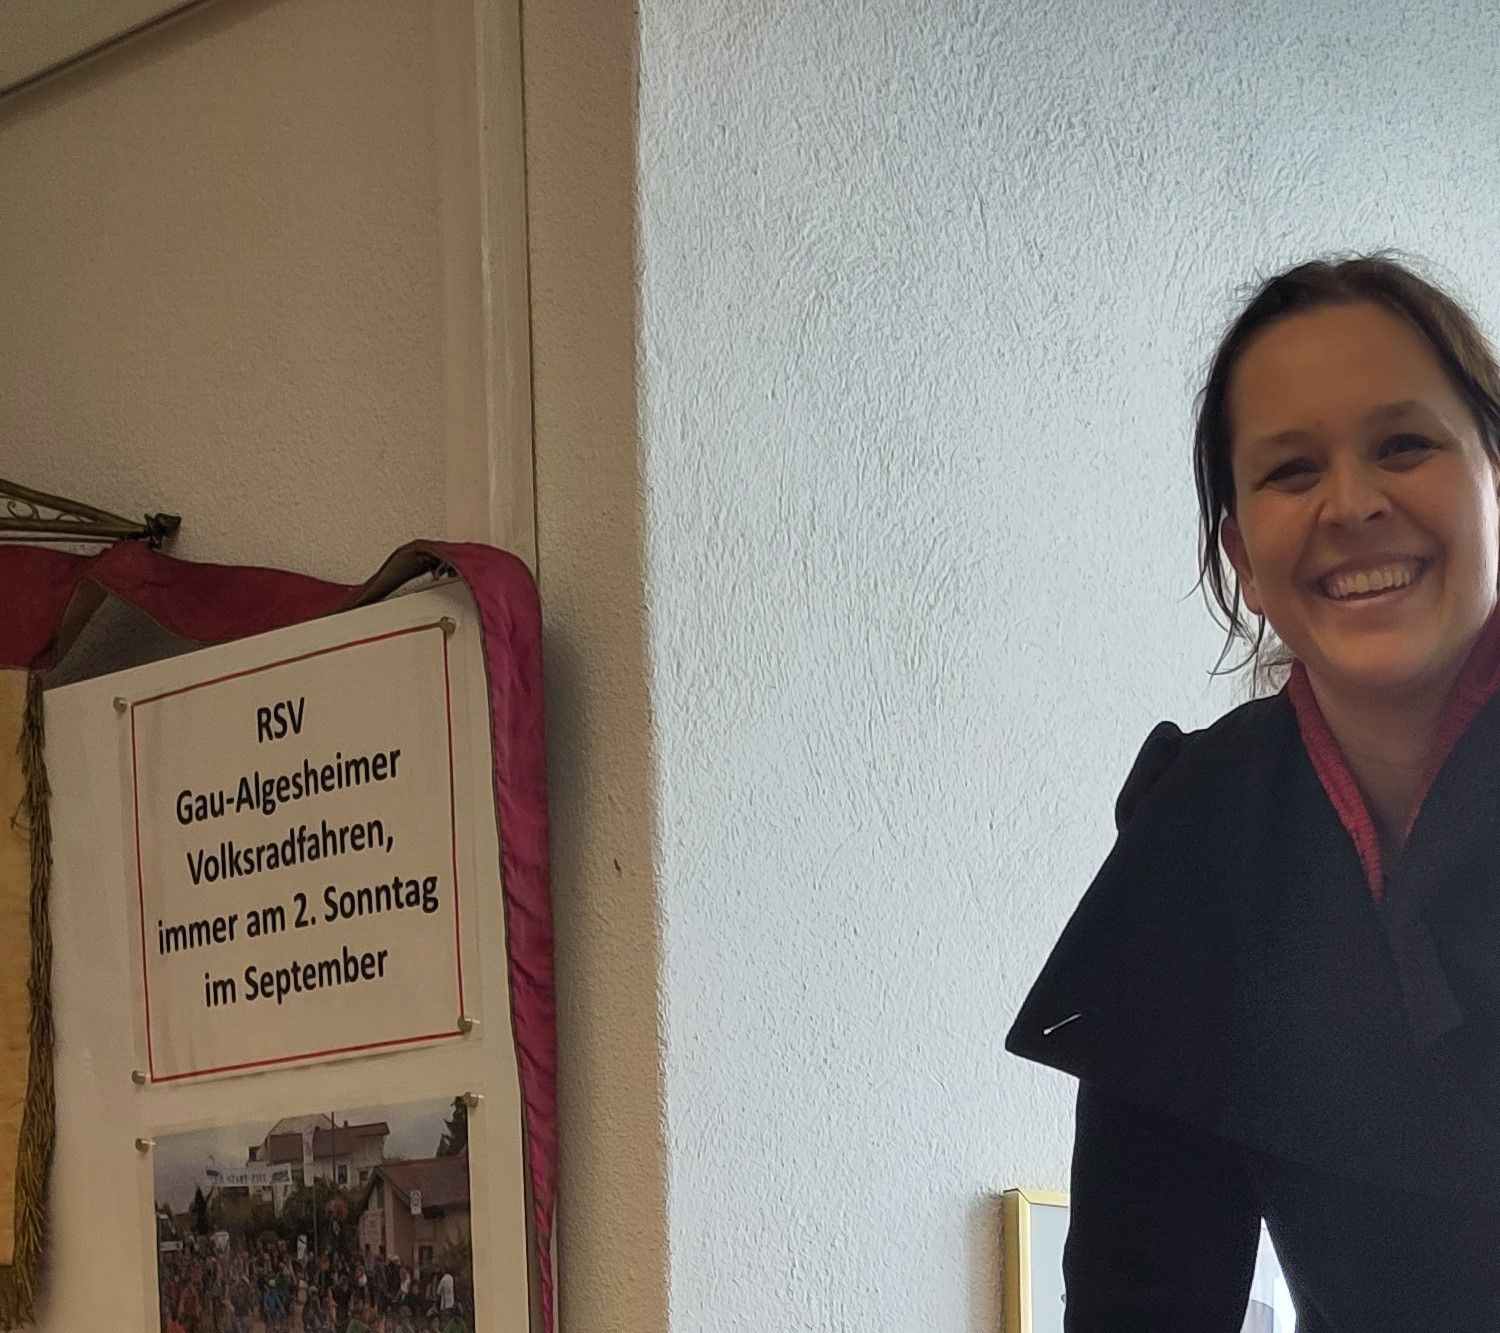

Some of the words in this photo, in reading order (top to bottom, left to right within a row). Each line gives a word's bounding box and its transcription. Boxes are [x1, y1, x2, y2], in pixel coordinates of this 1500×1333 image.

[257, 696, 305, 744] RSV
[176, 748, 402, 826] Gau-Algesheimer
[186, 819, 394, 886] Volksradfahren,
[157, 913, 239, 956] immer
[246, 905, 286, 938] am
[293, 891, 317, 929] 2.
[323, 875, 440, 923] Sonntag
[204, 971, 237, 1008] im
[244, 945, 389, 1006] September
